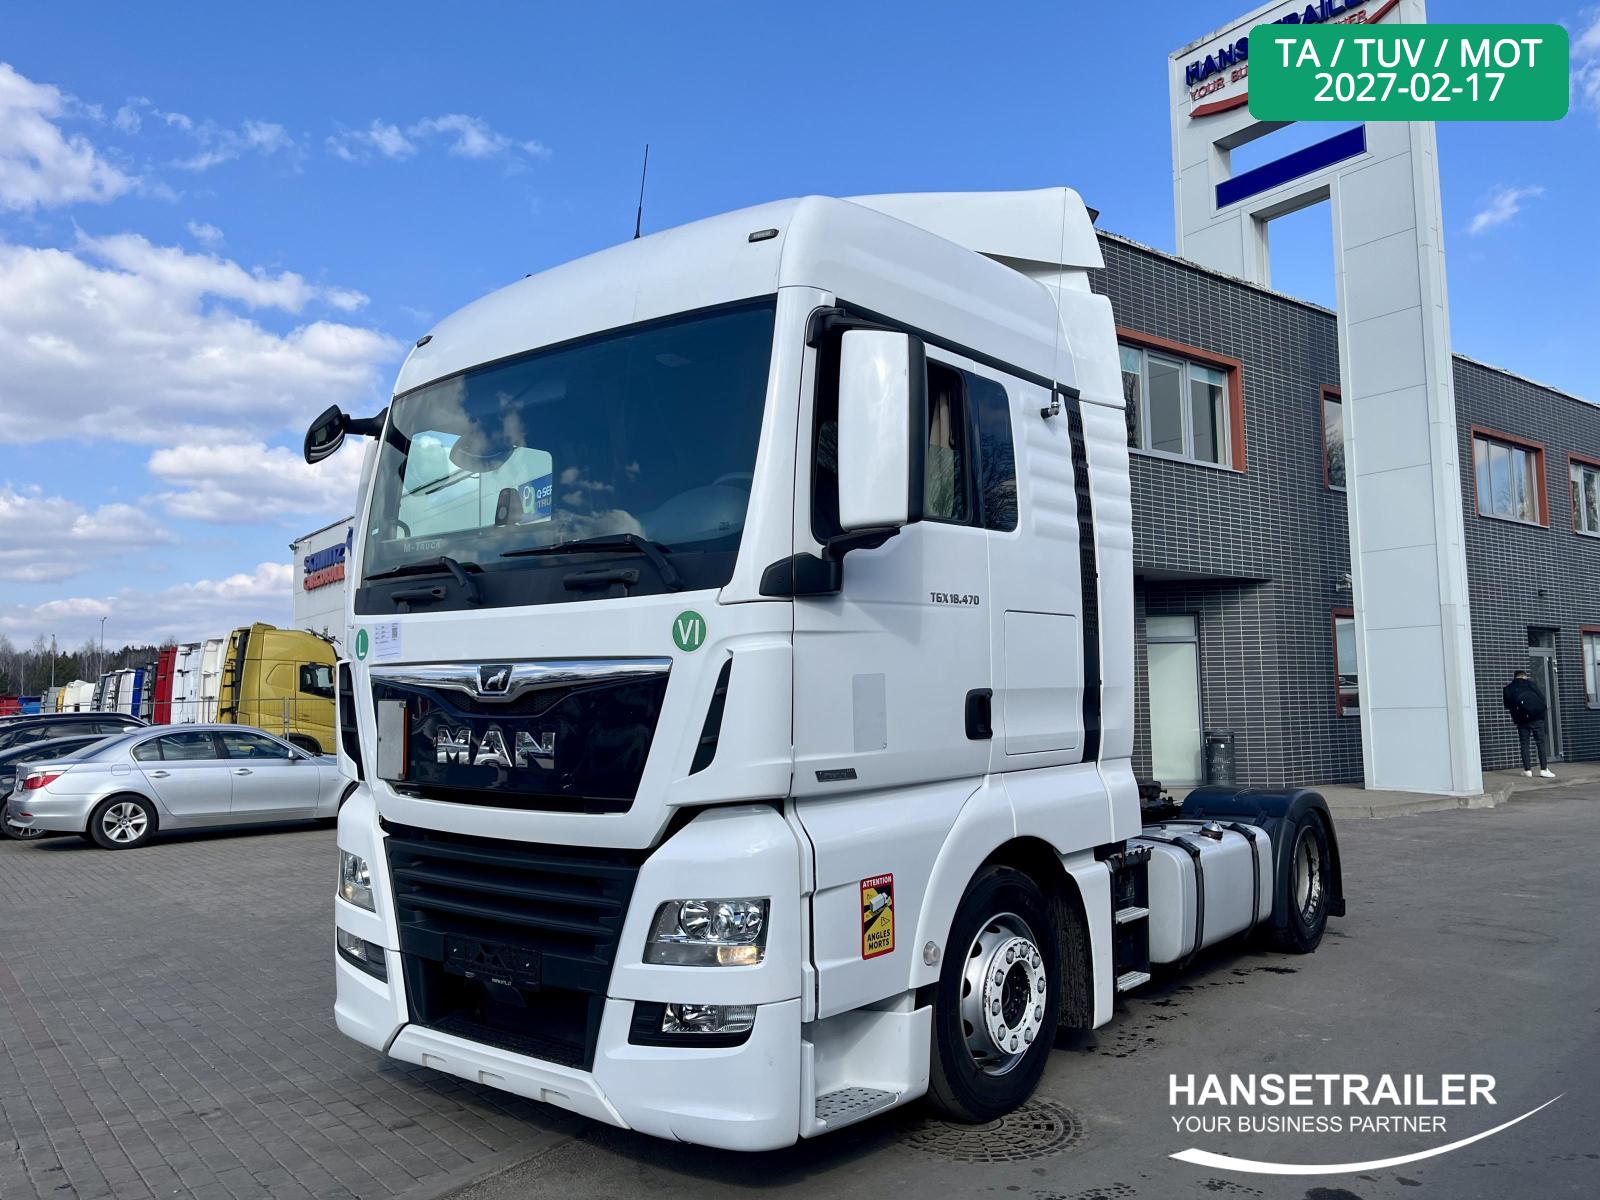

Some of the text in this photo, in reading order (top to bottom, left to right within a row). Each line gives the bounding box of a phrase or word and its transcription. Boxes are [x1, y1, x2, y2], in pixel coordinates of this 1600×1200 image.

[677, 619, 700, 645] VI
[358, 634, 366, 657] L
[436, 729, 556, 770] MAN
[862, 875, 892, 889] ATTENTION
[867, 928, 891, 942] ANGLES
[868, 938, 890, 951] MORTS
